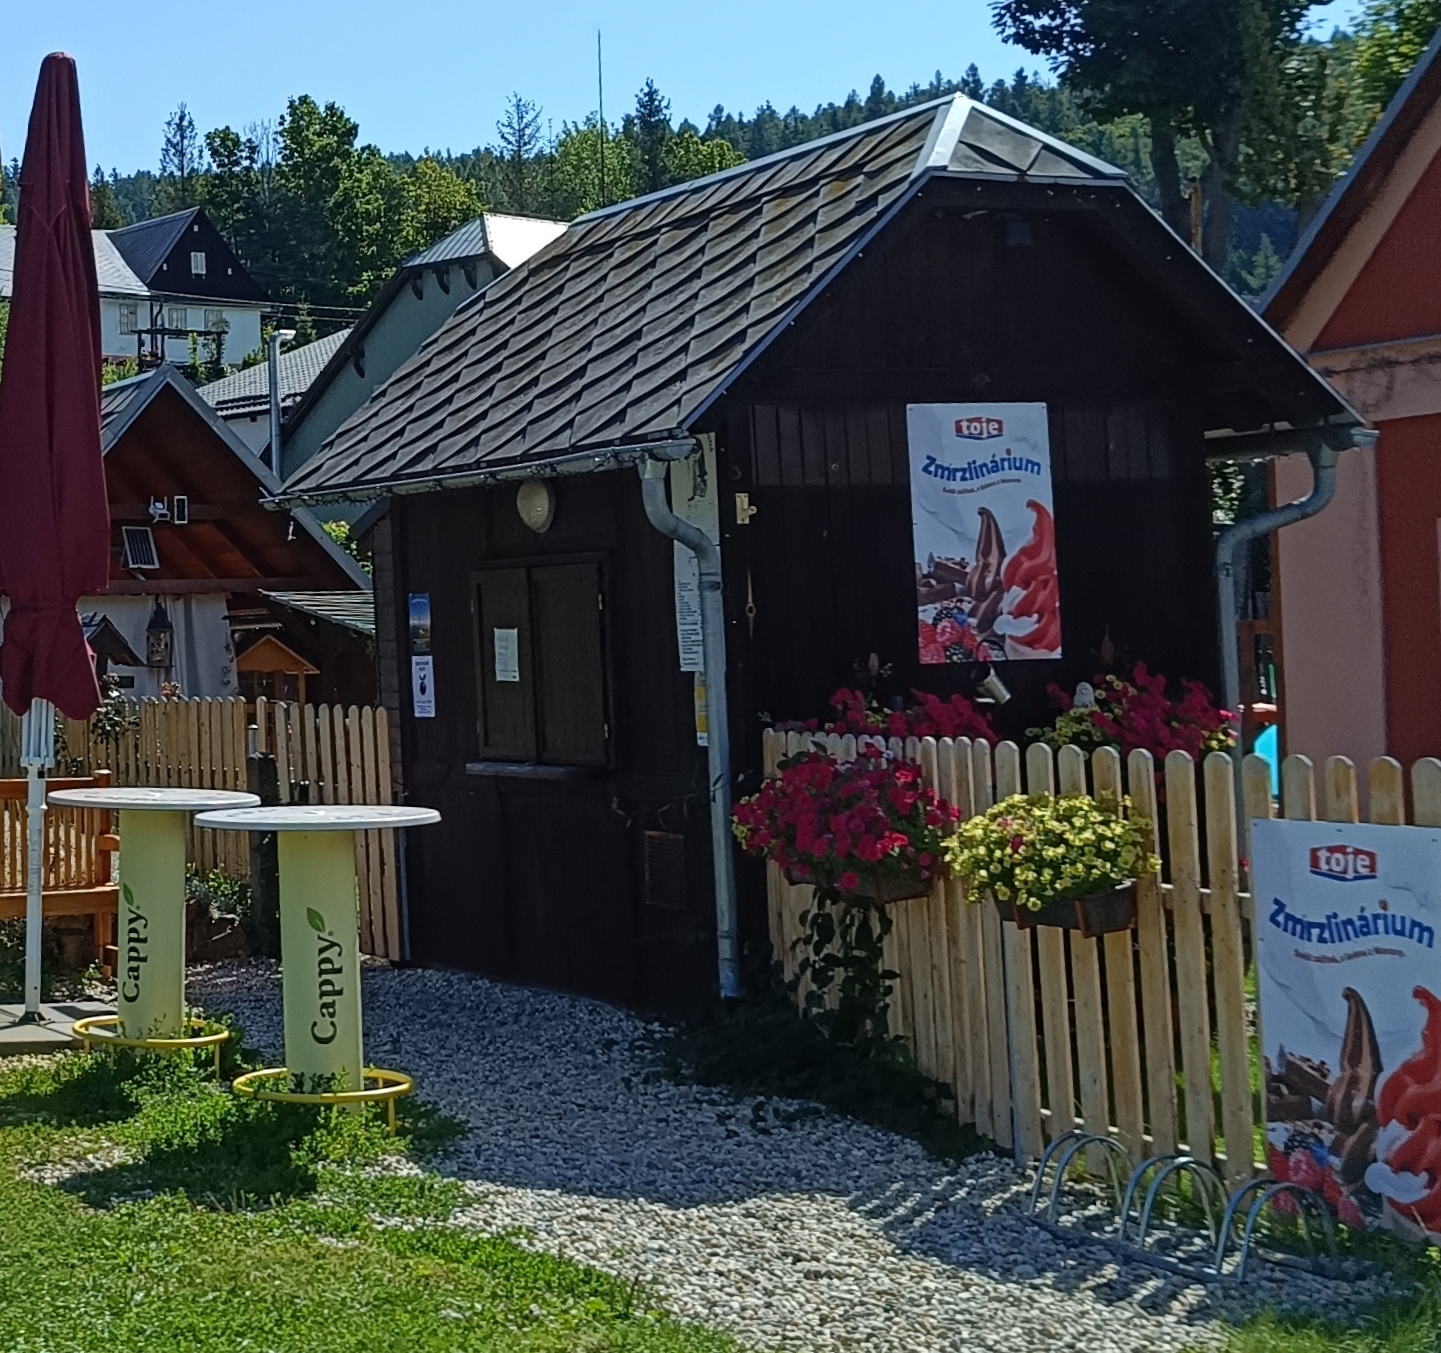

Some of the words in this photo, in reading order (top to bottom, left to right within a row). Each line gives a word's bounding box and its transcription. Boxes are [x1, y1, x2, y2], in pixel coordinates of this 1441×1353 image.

[960, 417, 999, 438] toje
[921, 450, 1041, 481] Zmrzlinárium
[1316, 847, 1371, 879] toje
[1268, 898, 1435, 949] Zmrzlinárium
[122, 906, 149, 1003] Cappy
[310, 933, 344, 1046] Cappy
